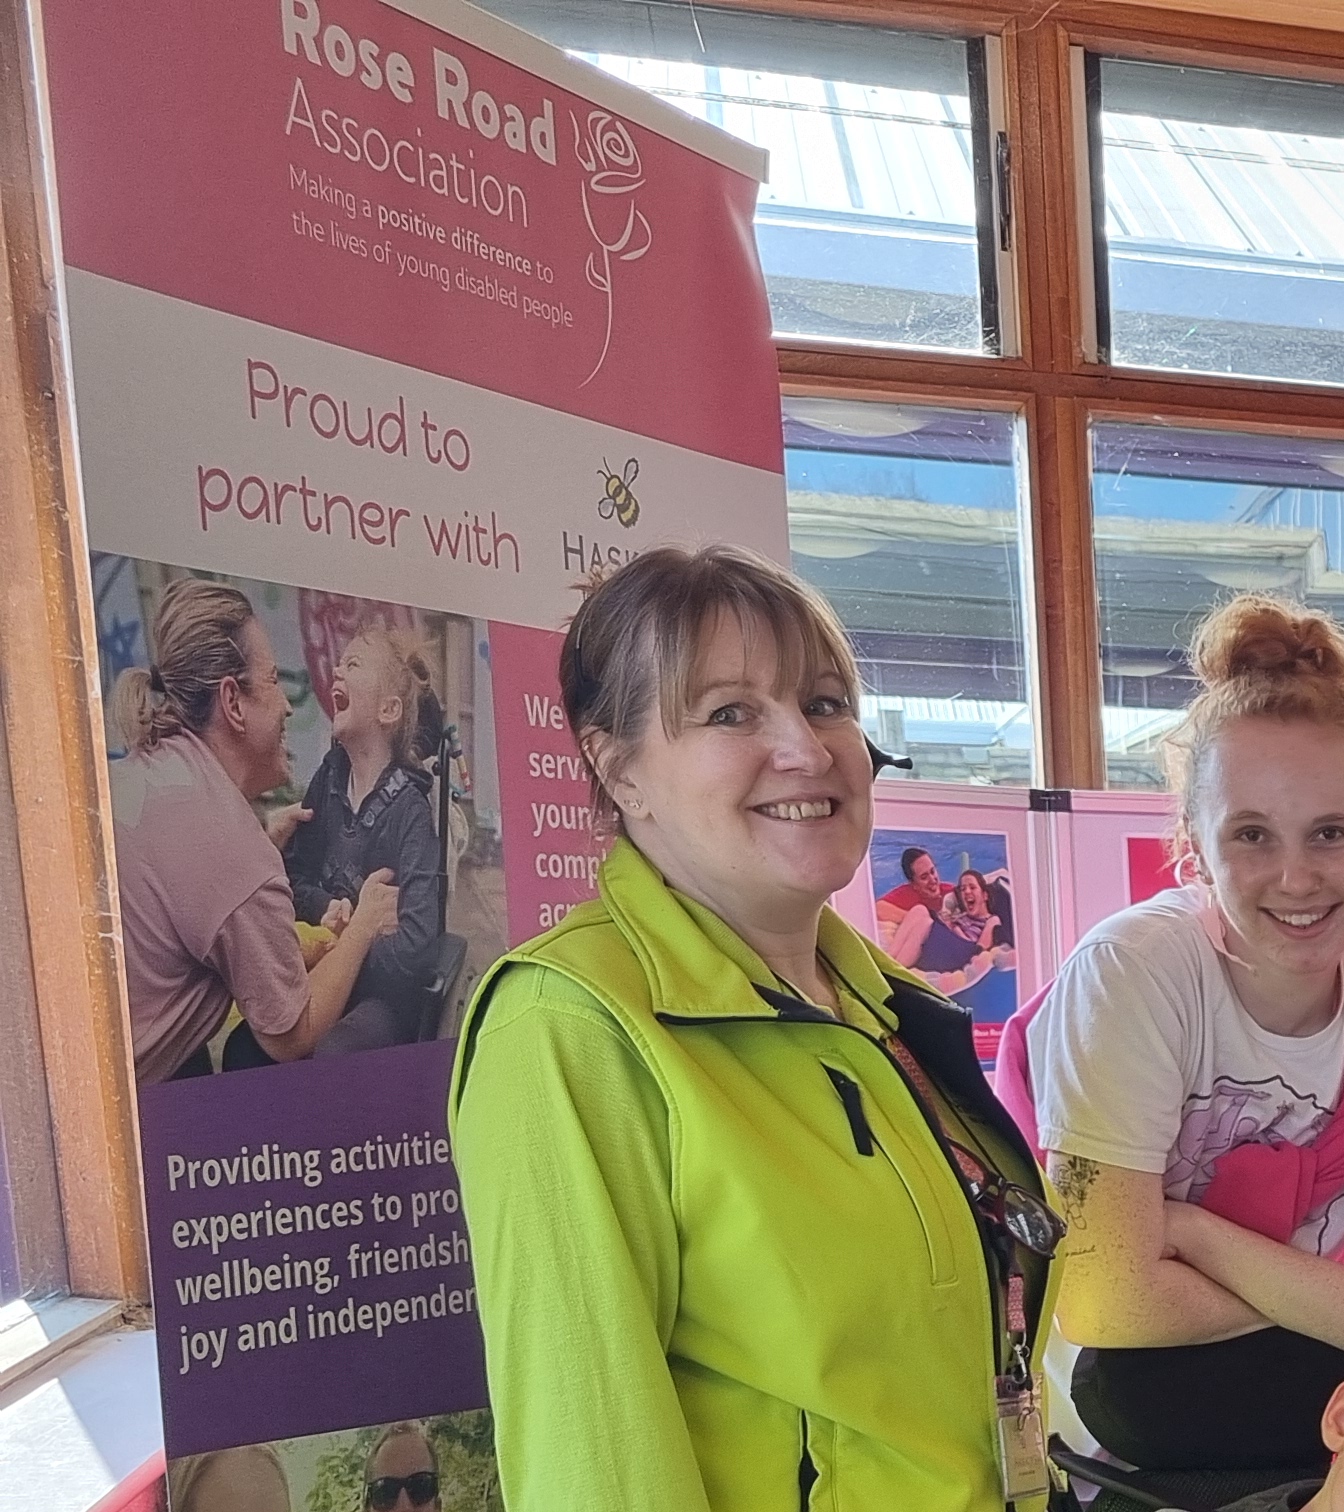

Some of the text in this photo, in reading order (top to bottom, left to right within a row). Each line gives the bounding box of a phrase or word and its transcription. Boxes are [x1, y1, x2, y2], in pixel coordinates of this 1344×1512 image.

[280, 0, 556, 166] Rose Road
[285, 78, 529, 228] Association
[289, 164, 554, 285] Making a positive difference to
[292, 211, 573, 329] the lives of young disabled people
[248, 358, 470, 472] Proud to
[199, 464, 409, 550] partner
[424, 511, 520, 572] with
[524, 694, 564, 729] We
[535, 848, 606, 889] comp
[167, 1132, 450, 1193] Providing activitie
[171, 1187, 459, 1255] experiences to pro
[176, 1231, 468, 1307] wellbeing, friendsh
[179, 1285, 477, 1375] joy and independen
